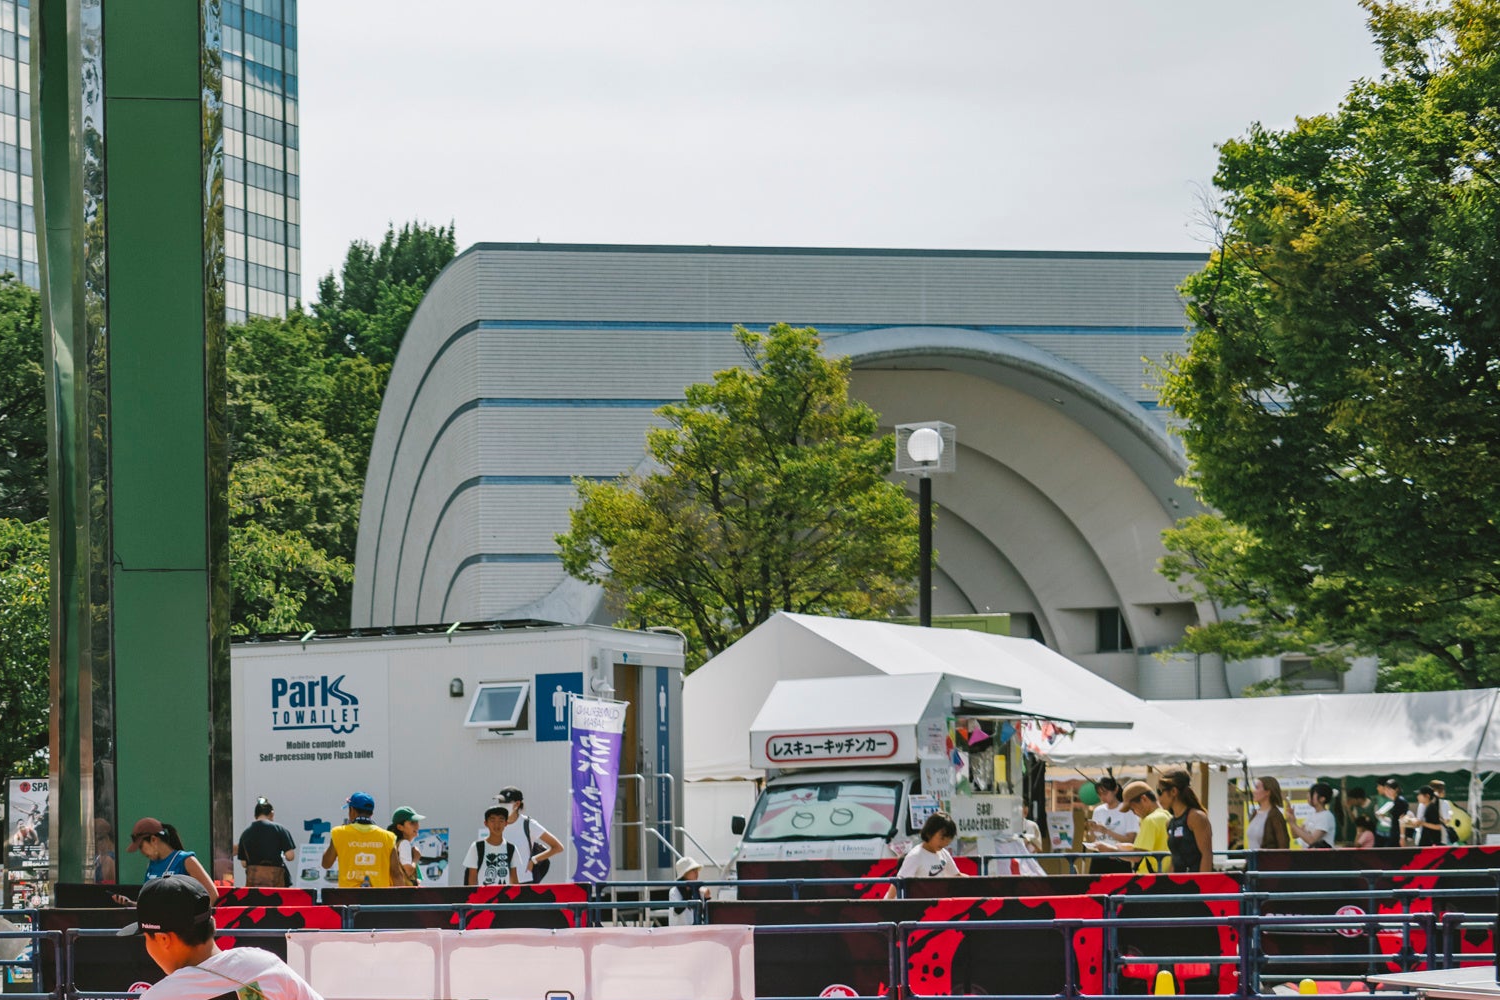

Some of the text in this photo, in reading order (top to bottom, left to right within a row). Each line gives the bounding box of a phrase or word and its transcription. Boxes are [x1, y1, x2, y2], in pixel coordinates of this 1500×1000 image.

[271, 675, 359, 708] Park
[272, 708, 359, 725] TOWAILET
[286, 740, 346, 749] Mobile complete
[773, 737, 887, 756] レスキューキッチンカー
[260, 750, 374, 762] Self-processing type Flush toilet
